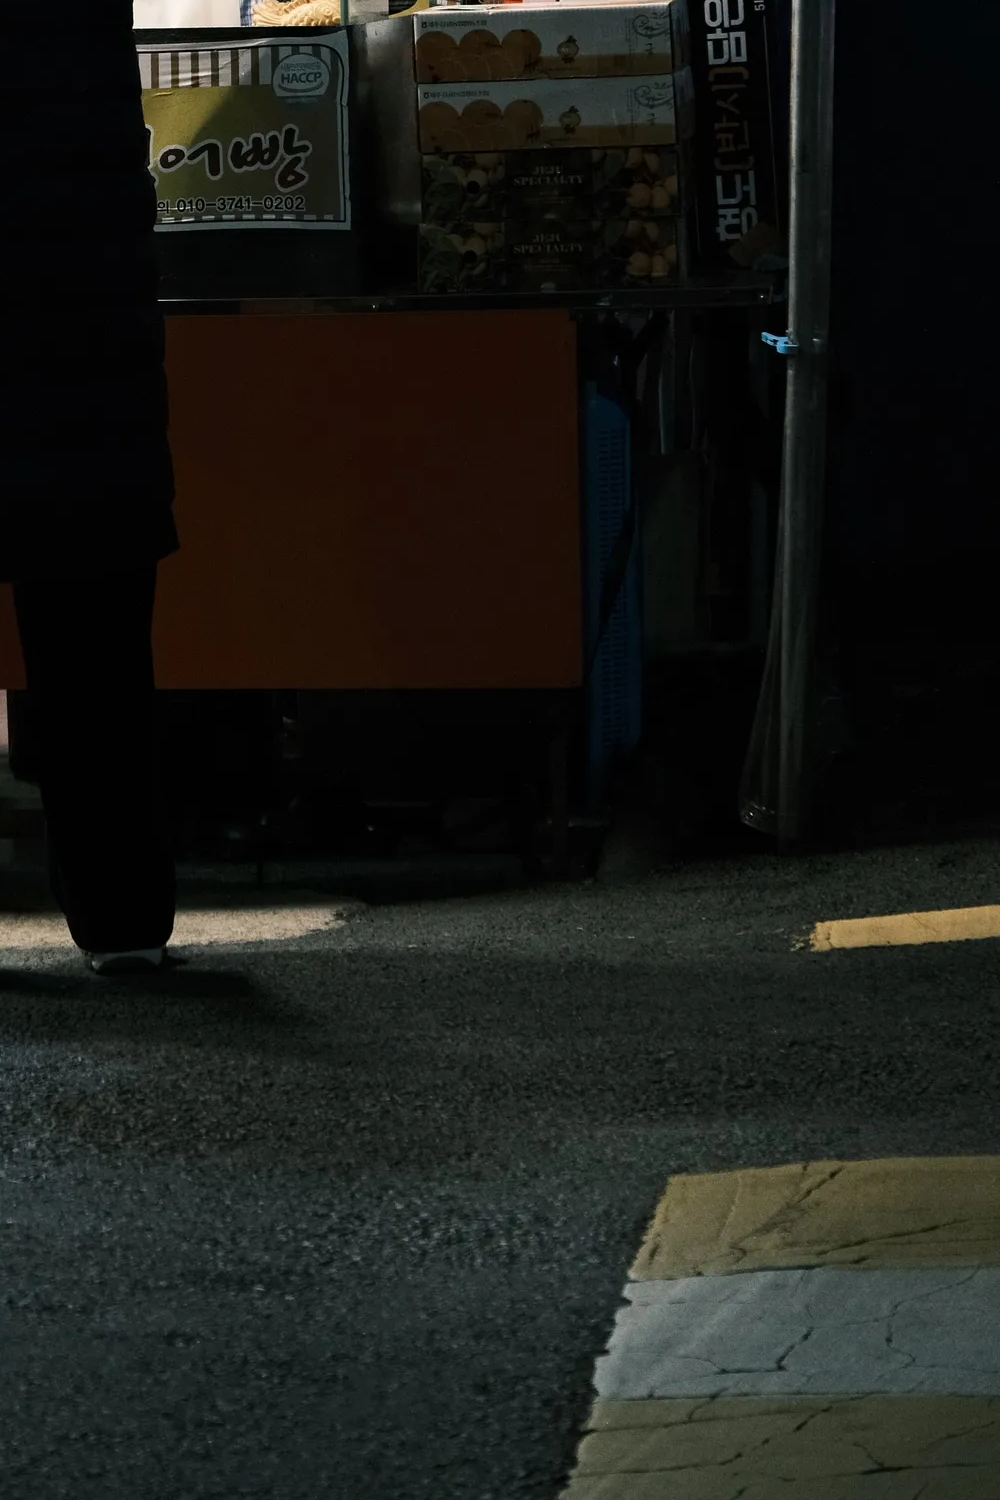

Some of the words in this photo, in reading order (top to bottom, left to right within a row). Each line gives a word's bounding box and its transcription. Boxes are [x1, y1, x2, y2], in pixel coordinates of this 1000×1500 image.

[281, 71, 322, 84] HACCP
[145, 124, 312, 192] 어빵
[156, 200, 170, 214] 의
[176, 197, 305, 213] 010-3741-0202
